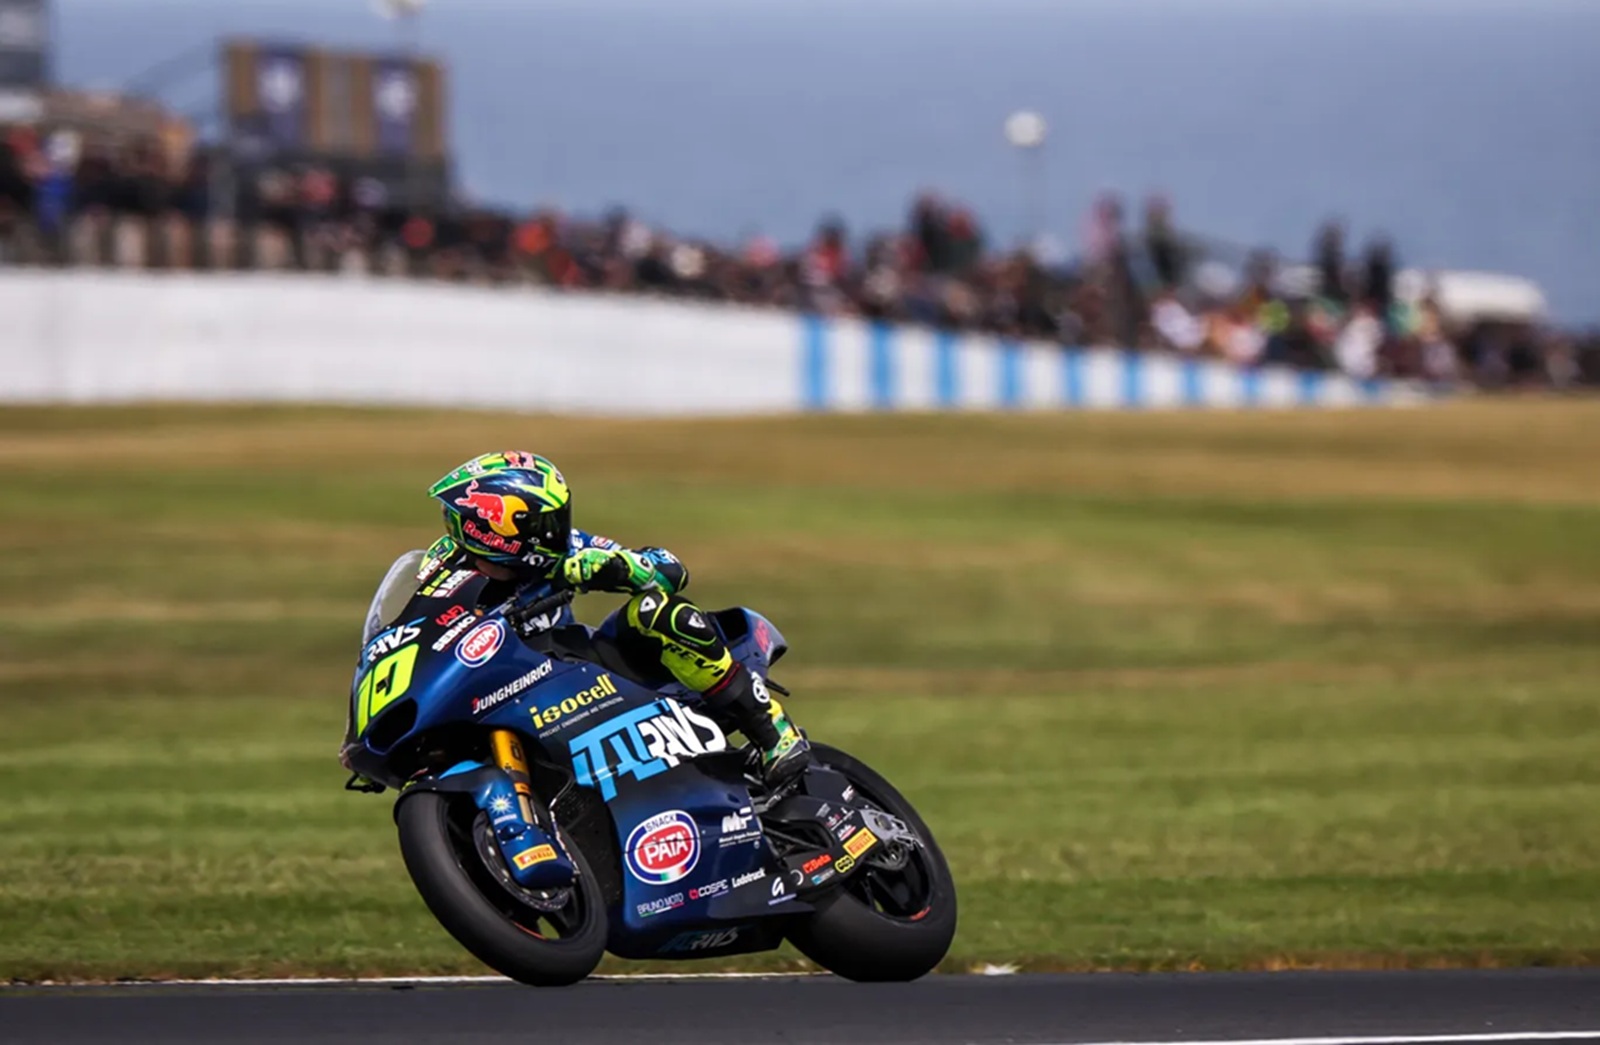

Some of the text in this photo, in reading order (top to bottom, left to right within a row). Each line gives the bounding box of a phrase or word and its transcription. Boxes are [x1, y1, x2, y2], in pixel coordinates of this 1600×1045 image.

[462, 519, 522, 555] Red Bull
[465, 625, 497, 657] PATA
[357, 643, 419, 738] 10
[472, 659, 553, 715] JUNGHEINRICH
[529, 673, 618, 730] isocell
[644, 813, 677, 832] SNACK
[644, 832, 689, 866] PATA
[636, 892, 685, 916] BRUNO MOTO
